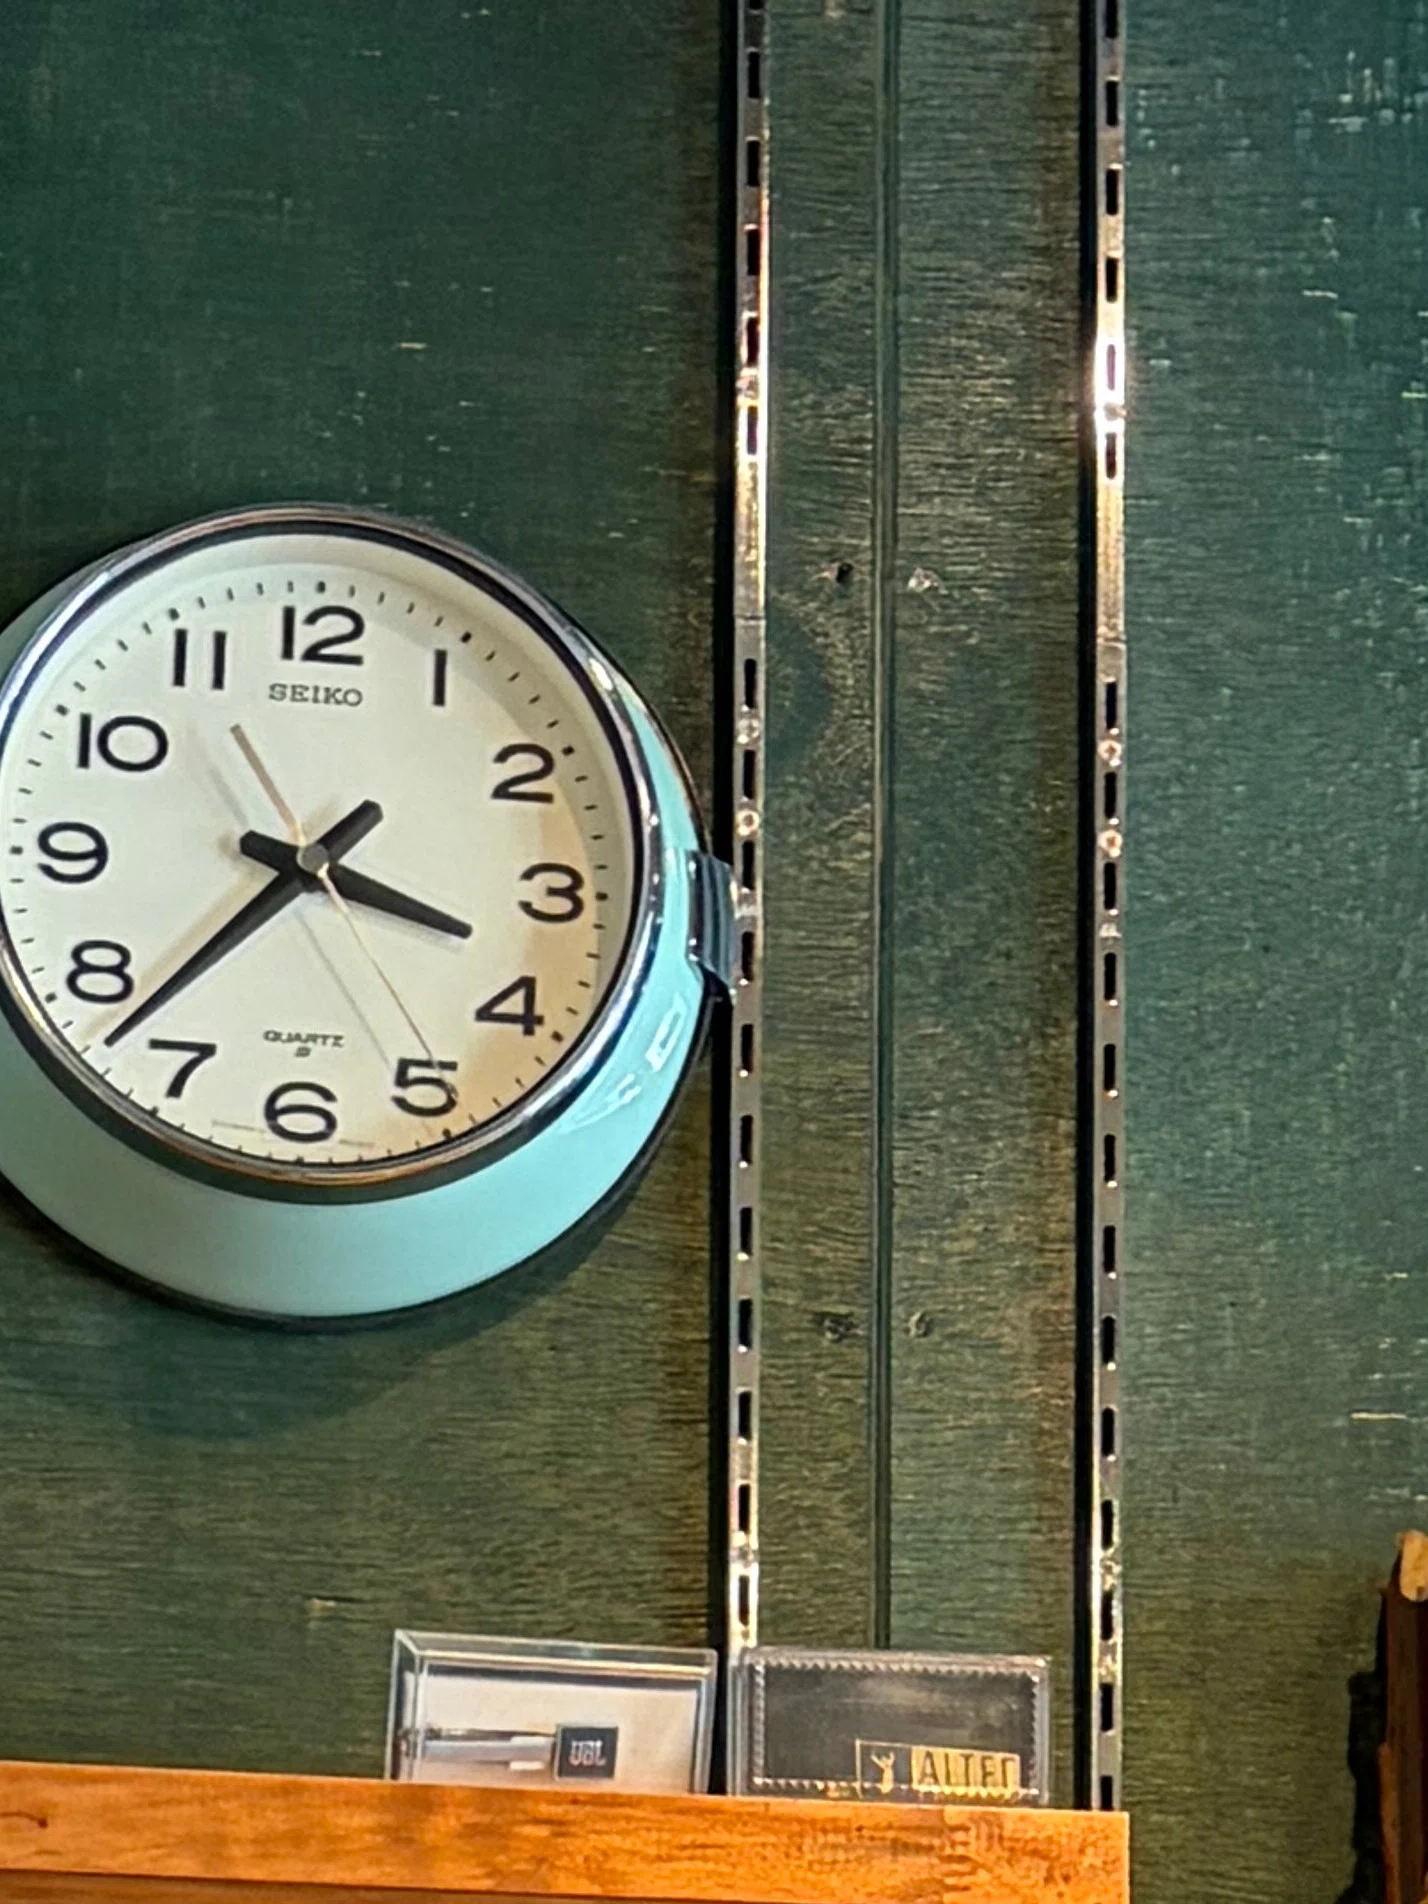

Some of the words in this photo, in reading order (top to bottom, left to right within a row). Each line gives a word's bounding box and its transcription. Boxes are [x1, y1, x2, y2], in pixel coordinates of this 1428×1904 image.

[172, 627, 226, 691] 11
[281, 605, 364, 665] 12
[268, 681, 363, 708] SEIKO
[432, 648, 448, 707] 1
[77, 713, 168, 773] 10
[492, 743, 556, 802] 2
[37, 821, 108, 884] 9
[518, 863, 585, 924] 3
[66, 940, 135, 1005] 8
[475, 975, 545, 1038] 4
[147, 1038, 217, 1098] 7
[262, 1028, 345, 1049] QUARTZ
[265, 1081, 338, 1144] 6
[391, 1057, 458, 1118] 5
